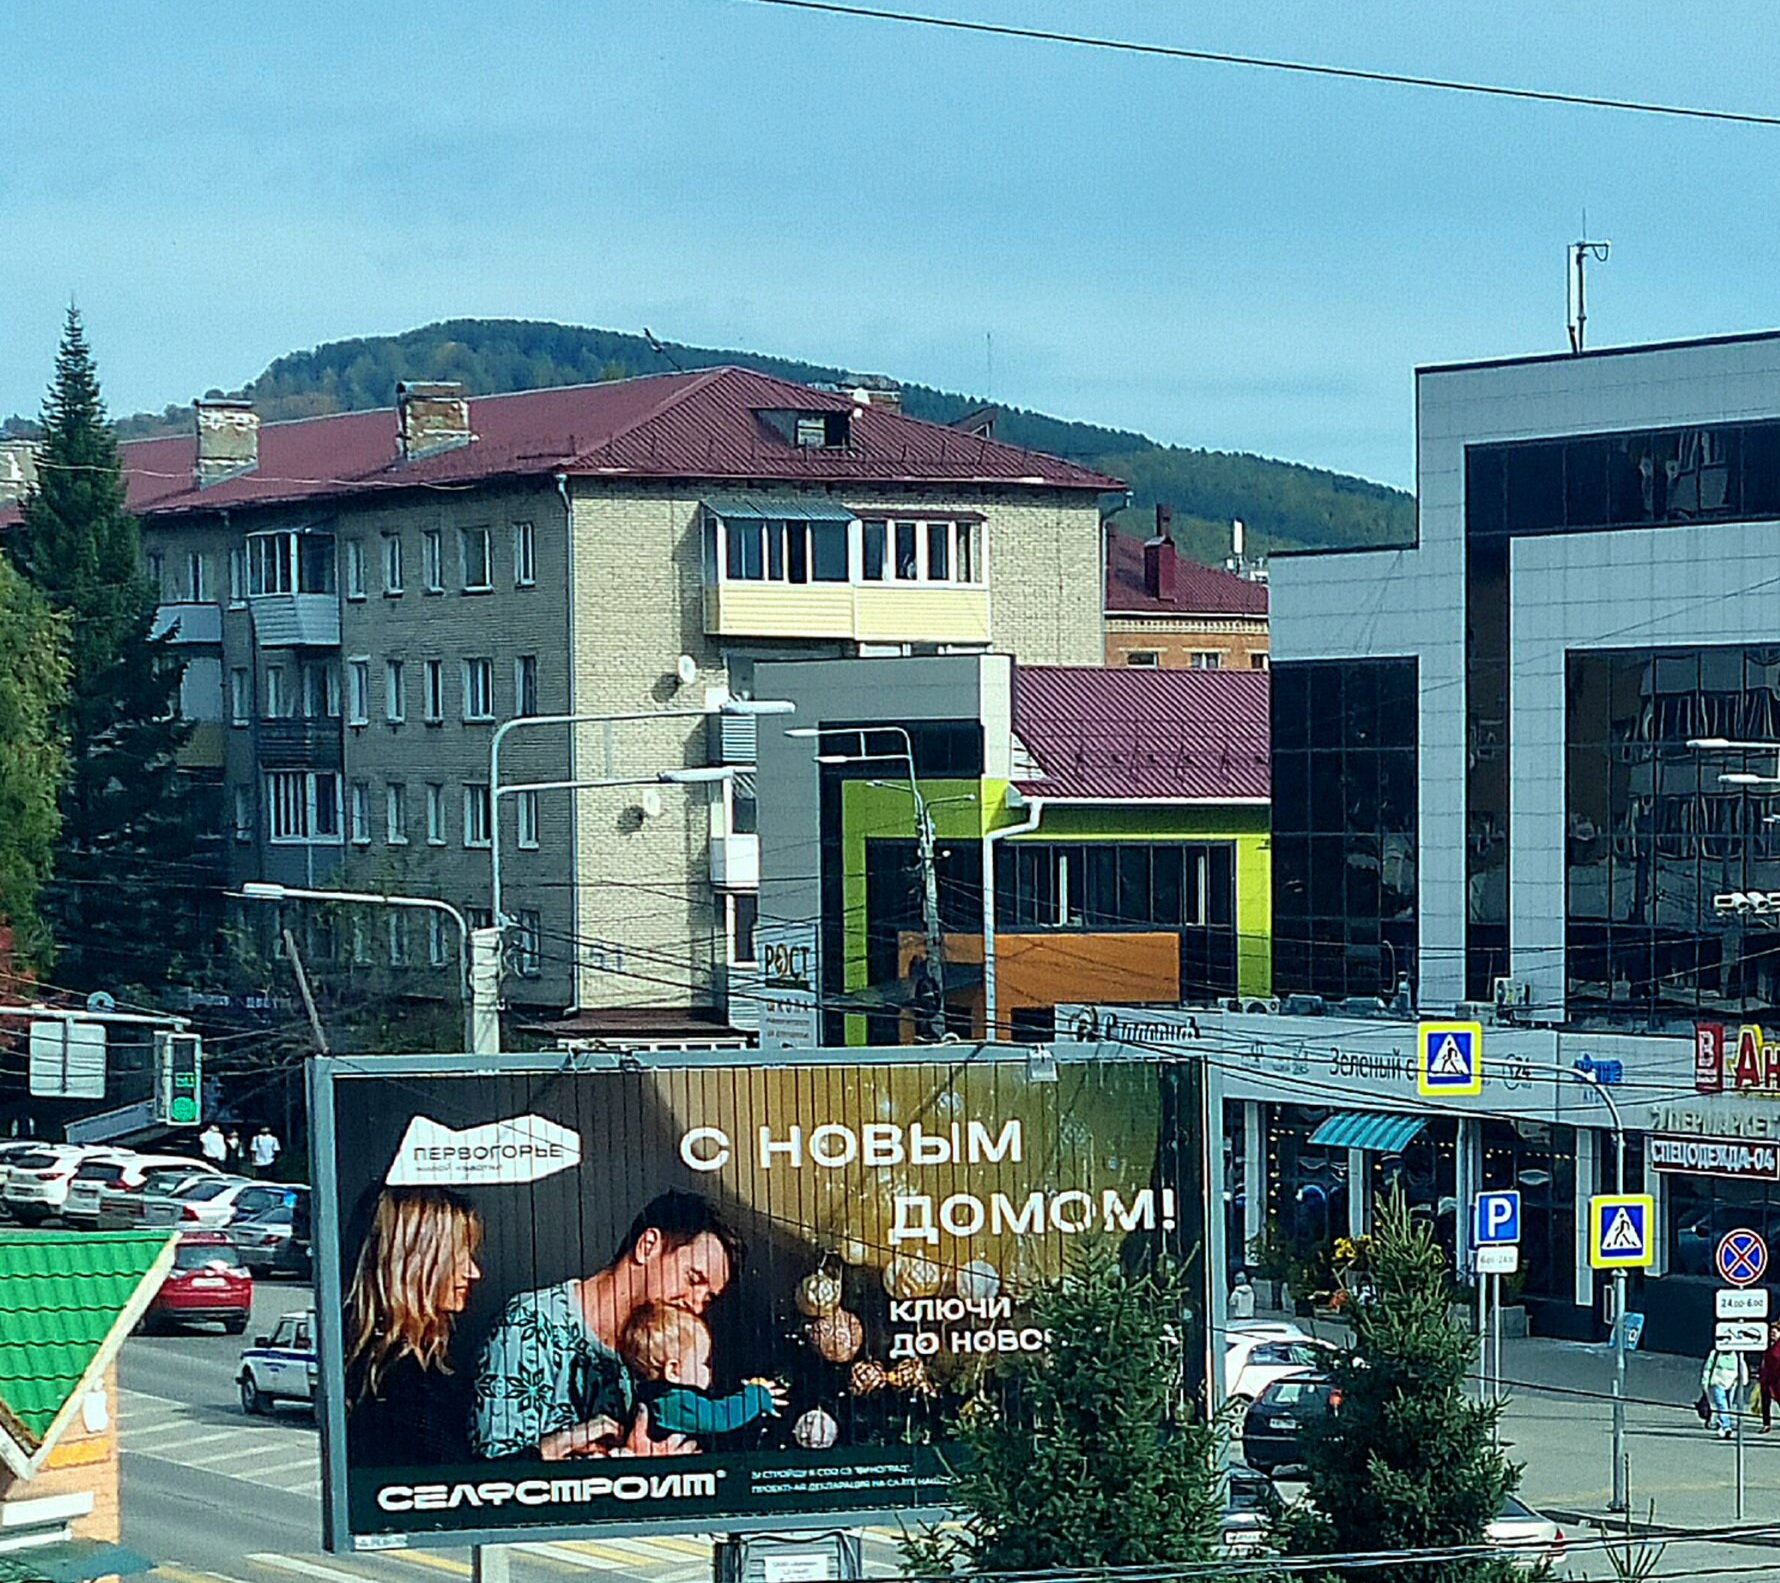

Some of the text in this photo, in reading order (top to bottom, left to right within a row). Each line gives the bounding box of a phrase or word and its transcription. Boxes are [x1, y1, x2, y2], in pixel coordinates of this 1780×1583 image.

[1329, 1044, 1402, 1080] Зеленый
[413, 1143, 563, 1161] ПЕРВОГОРЬЕ
[680, 1119, 1023, 1171] С НОВЫМ
[1651, 1140, 1776, 1172] СПЕЦОДЕЖДА-04
[888, 1187, 1177, 1245] ДОМОМ!
[1488, 1197, 1512, 1238] P
[889, 1297, 1012, 1323] КЛЮЧИ
[889, 1327, 1055, 1359] ДО НОВО
